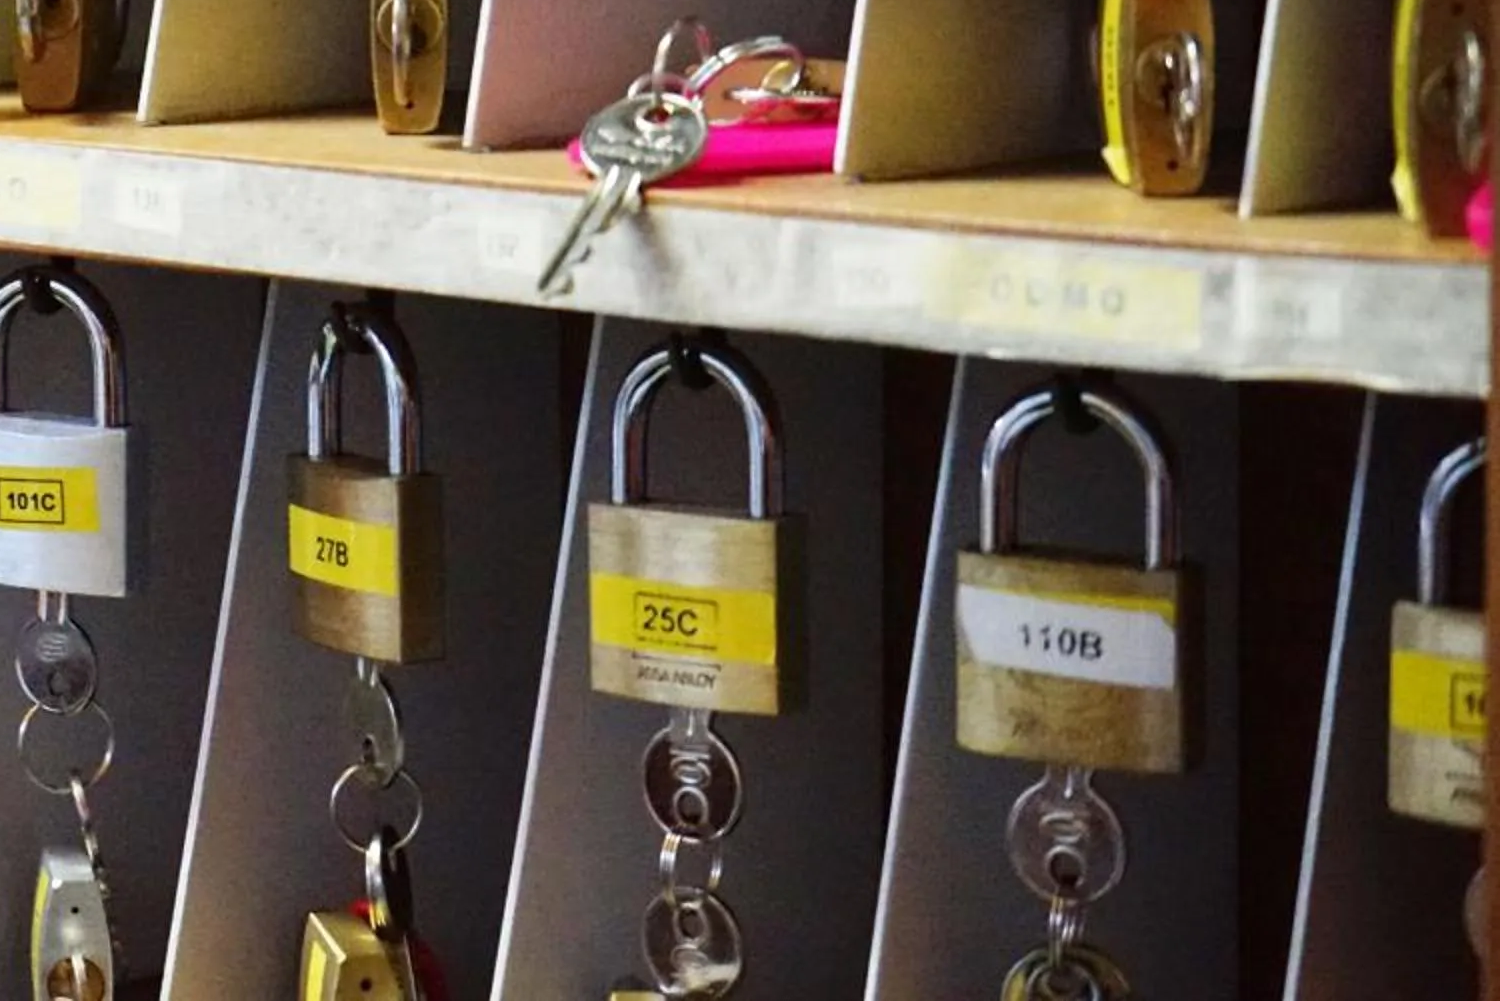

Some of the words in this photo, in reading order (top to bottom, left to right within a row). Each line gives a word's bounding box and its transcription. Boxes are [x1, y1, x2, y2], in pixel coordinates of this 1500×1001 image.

[5, 492, 56, 512] 101C
[315, 536, 349, 568] 27B
[643, 603, 699, 637] 25C
[1018, 623, 1104, 661] 110B
